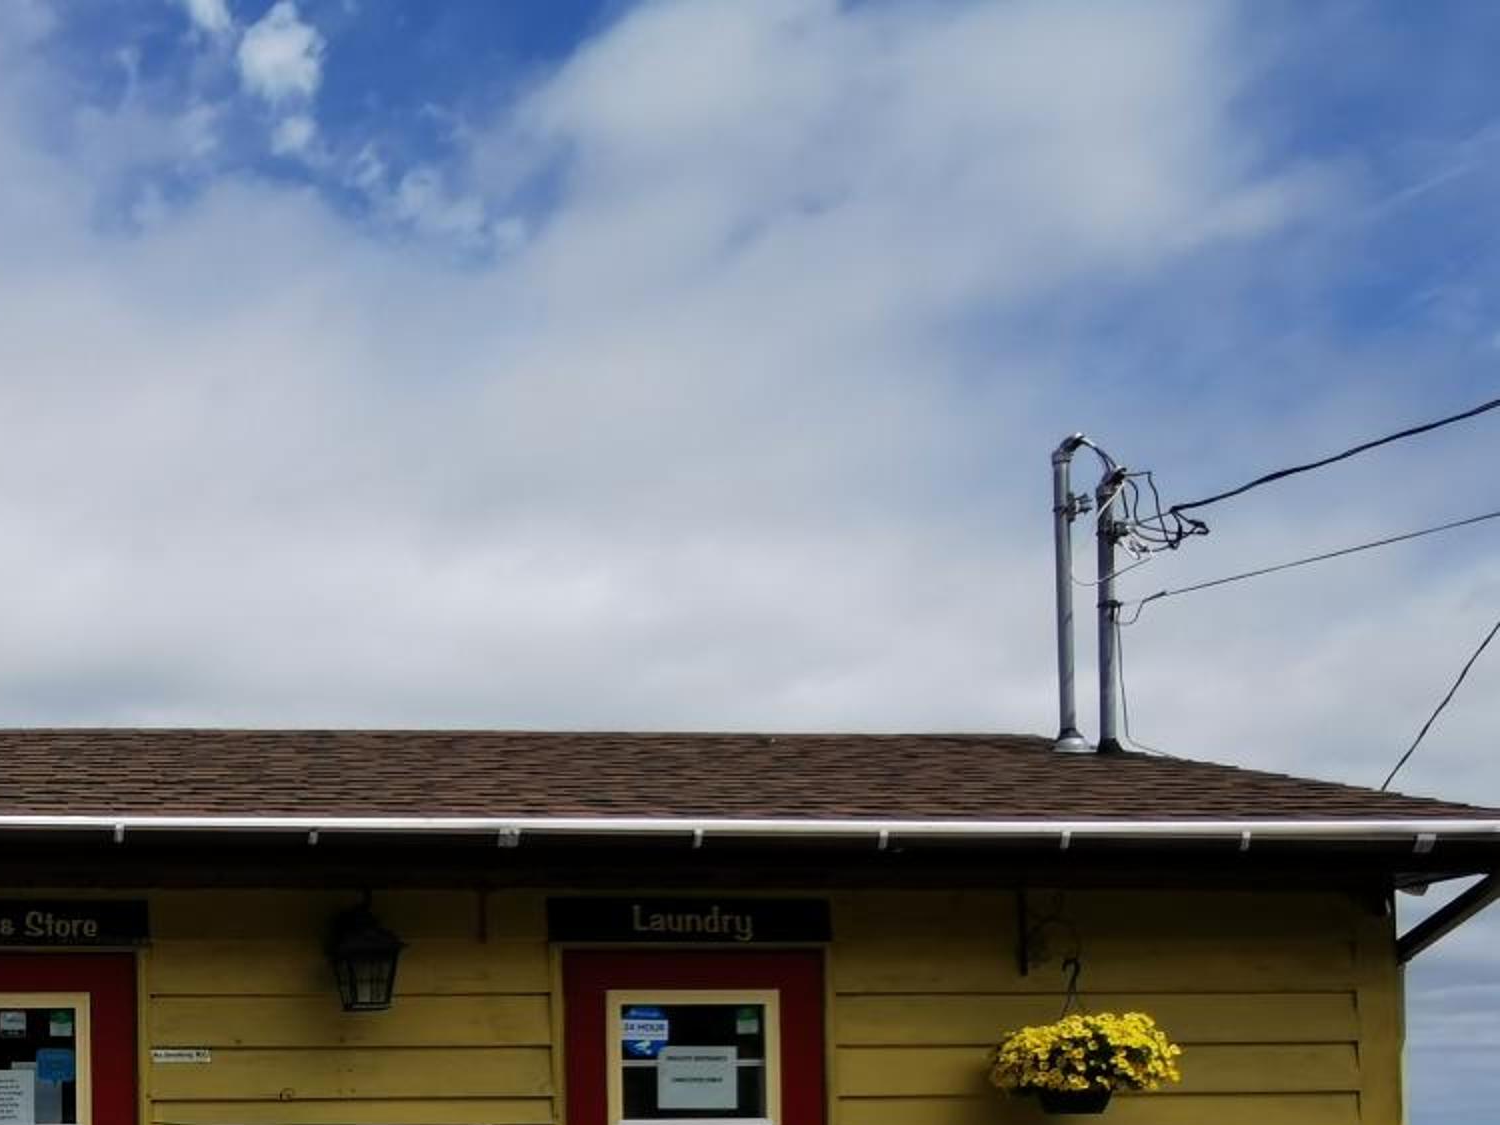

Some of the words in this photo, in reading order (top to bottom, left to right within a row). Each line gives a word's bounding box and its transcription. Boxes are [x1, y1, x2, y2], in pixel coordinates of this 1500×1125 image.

[25, 910, 98, 937] Store
[633, 905, 753, 942] Laundry
[638, 1023, 666, 1033] HOUR
